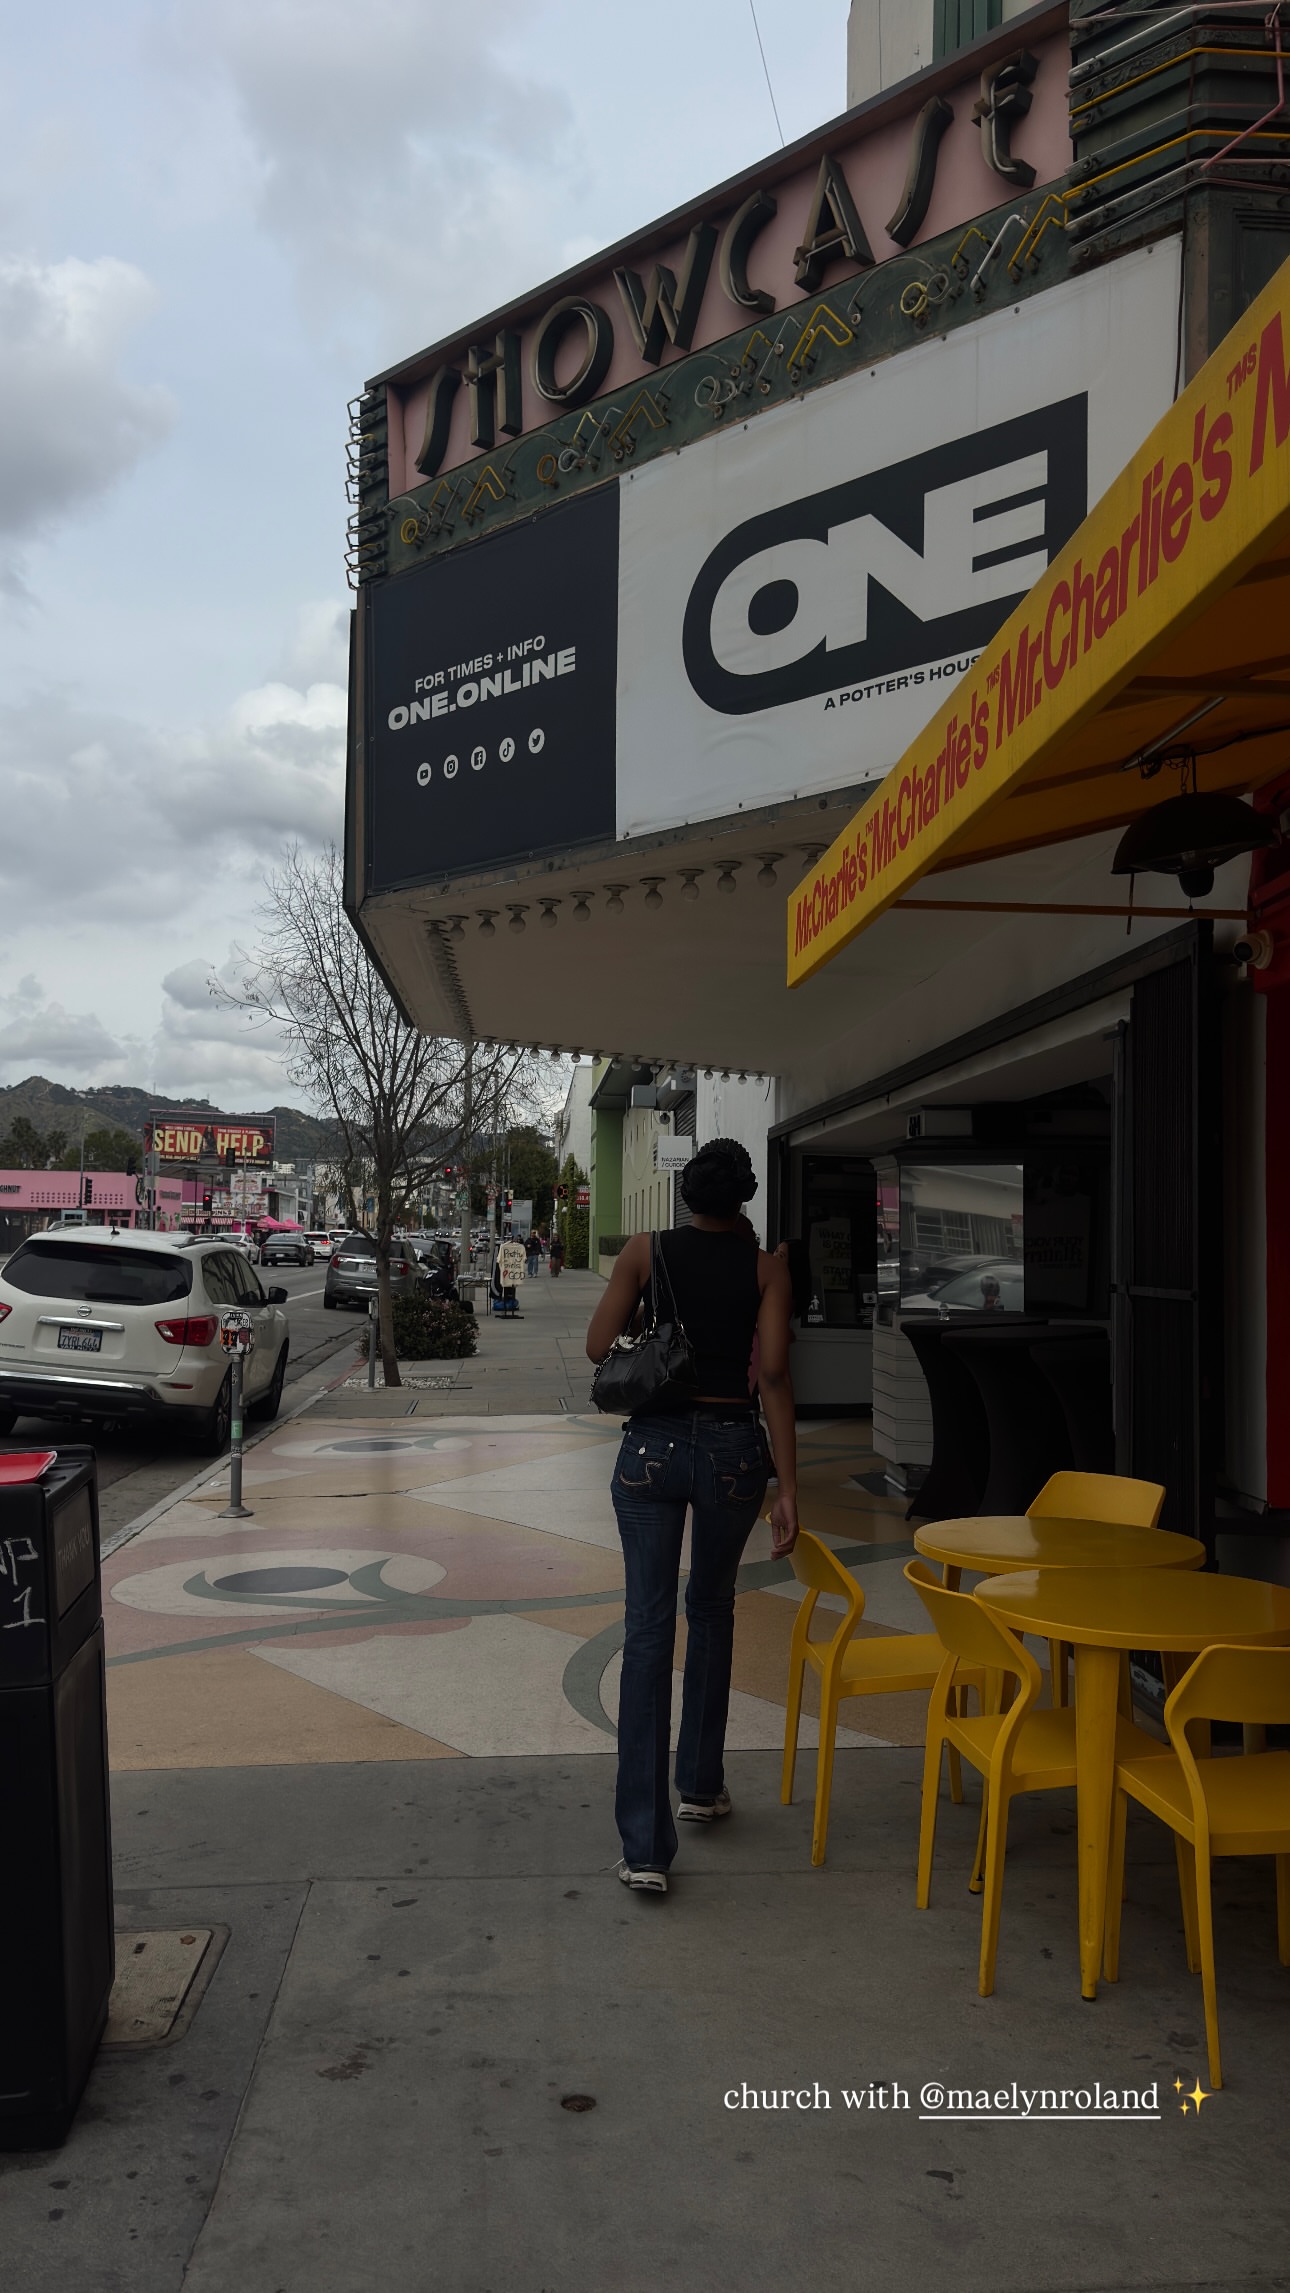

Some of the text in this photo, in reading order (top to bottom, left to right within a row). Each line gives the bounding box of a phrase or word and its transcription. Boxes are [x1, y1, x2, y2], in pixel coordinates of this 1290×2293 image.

[414, 47, 1038, 478] SHOWCASE
[709, 448, 1048, 677] ONE
[388, 646, 576, 731] ONE.ONLINE
[415, 635, 546, 693] FOR TIMES + INFO
[794, 832, 869, 958] Mr.Charlie's
[870, 690, 990, 880] Mr.Charlie's
[996, 403, 1233, 749] Mr.Charlie's
[823, 697, 837, 711] A
[839, 671, 926, 706] POTTER'S
[153, 1129, 265, 1157] SEND HELP
[508, 1271, 526, 1280] GOD
[61, 1334, 98, 1348] 7YRL644
[57, 1524, 90, 1576] THANK YOU
